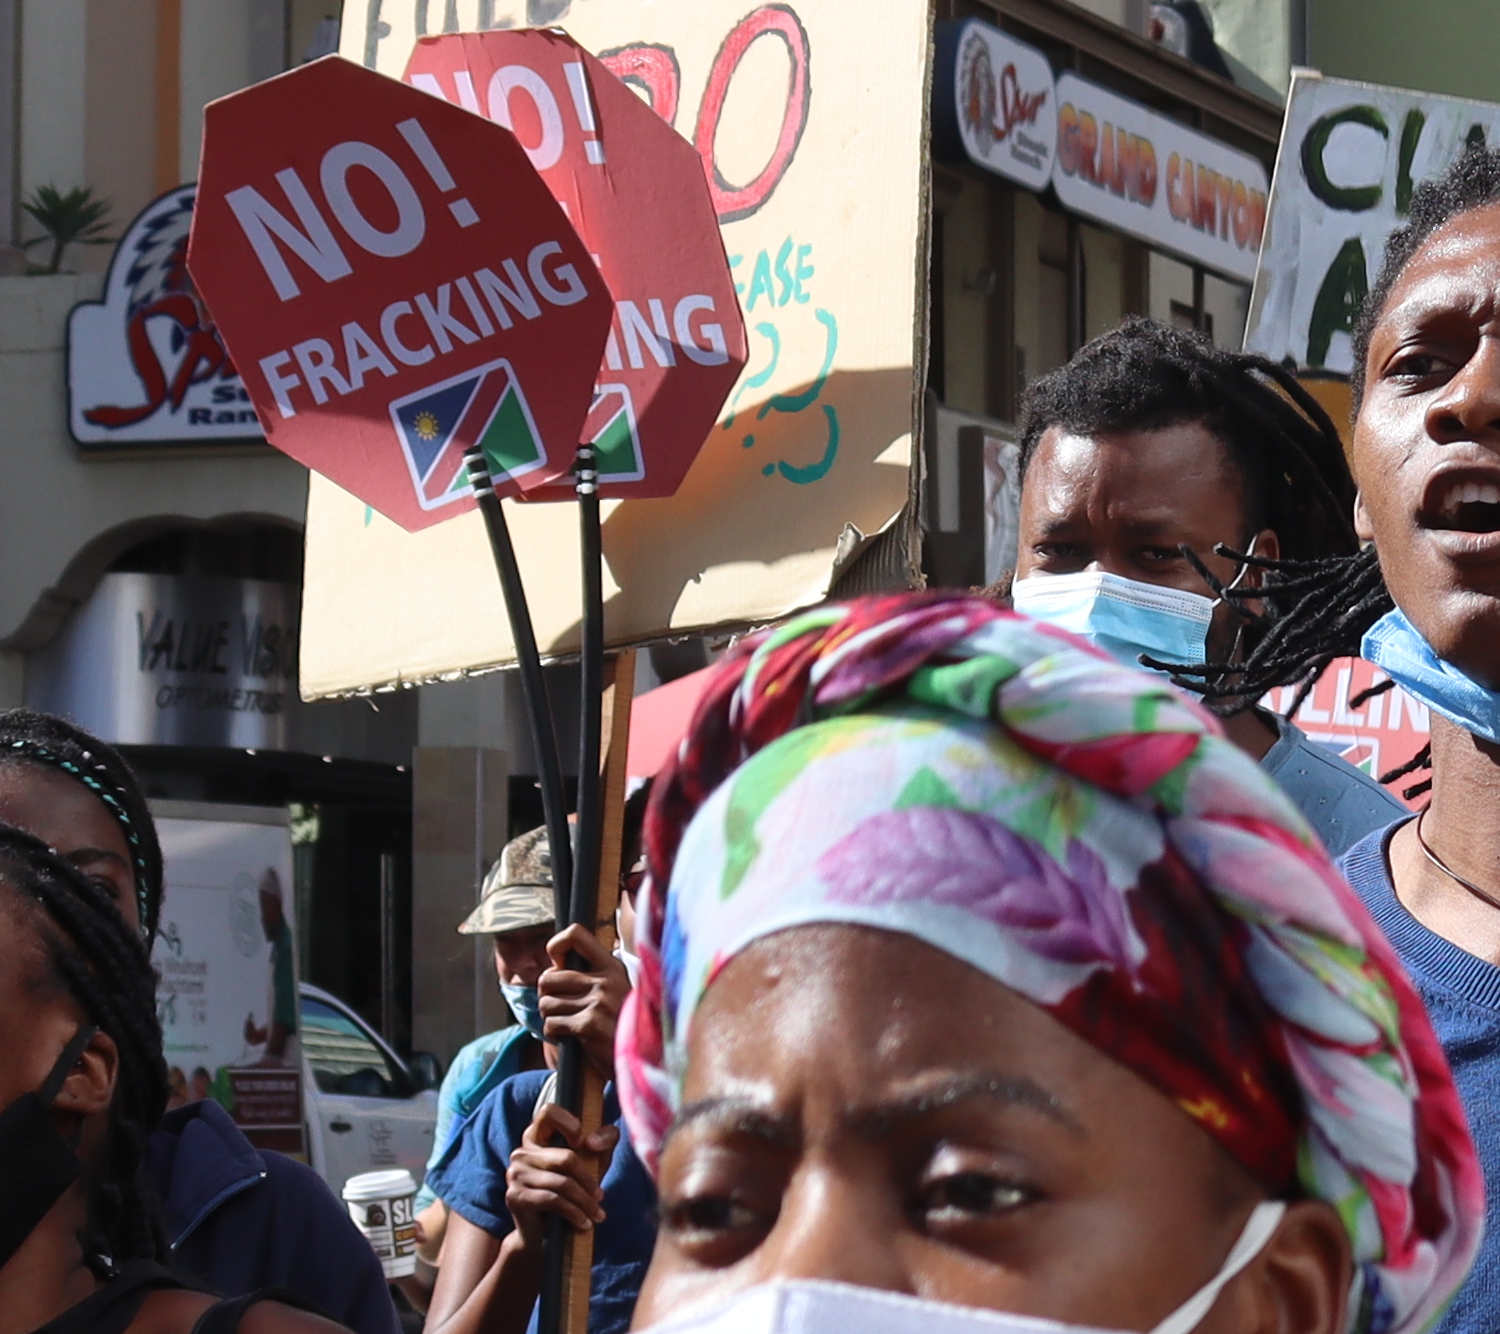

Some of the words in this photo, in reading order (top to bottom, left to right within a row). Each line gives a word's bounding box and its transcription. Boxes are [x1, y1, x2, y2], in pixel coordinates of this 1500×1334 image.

[223, 117, 480, 303] NO!
[1057, 101, 1157, 208] GRAND
[259, 240, 589, 420] FRACKING
